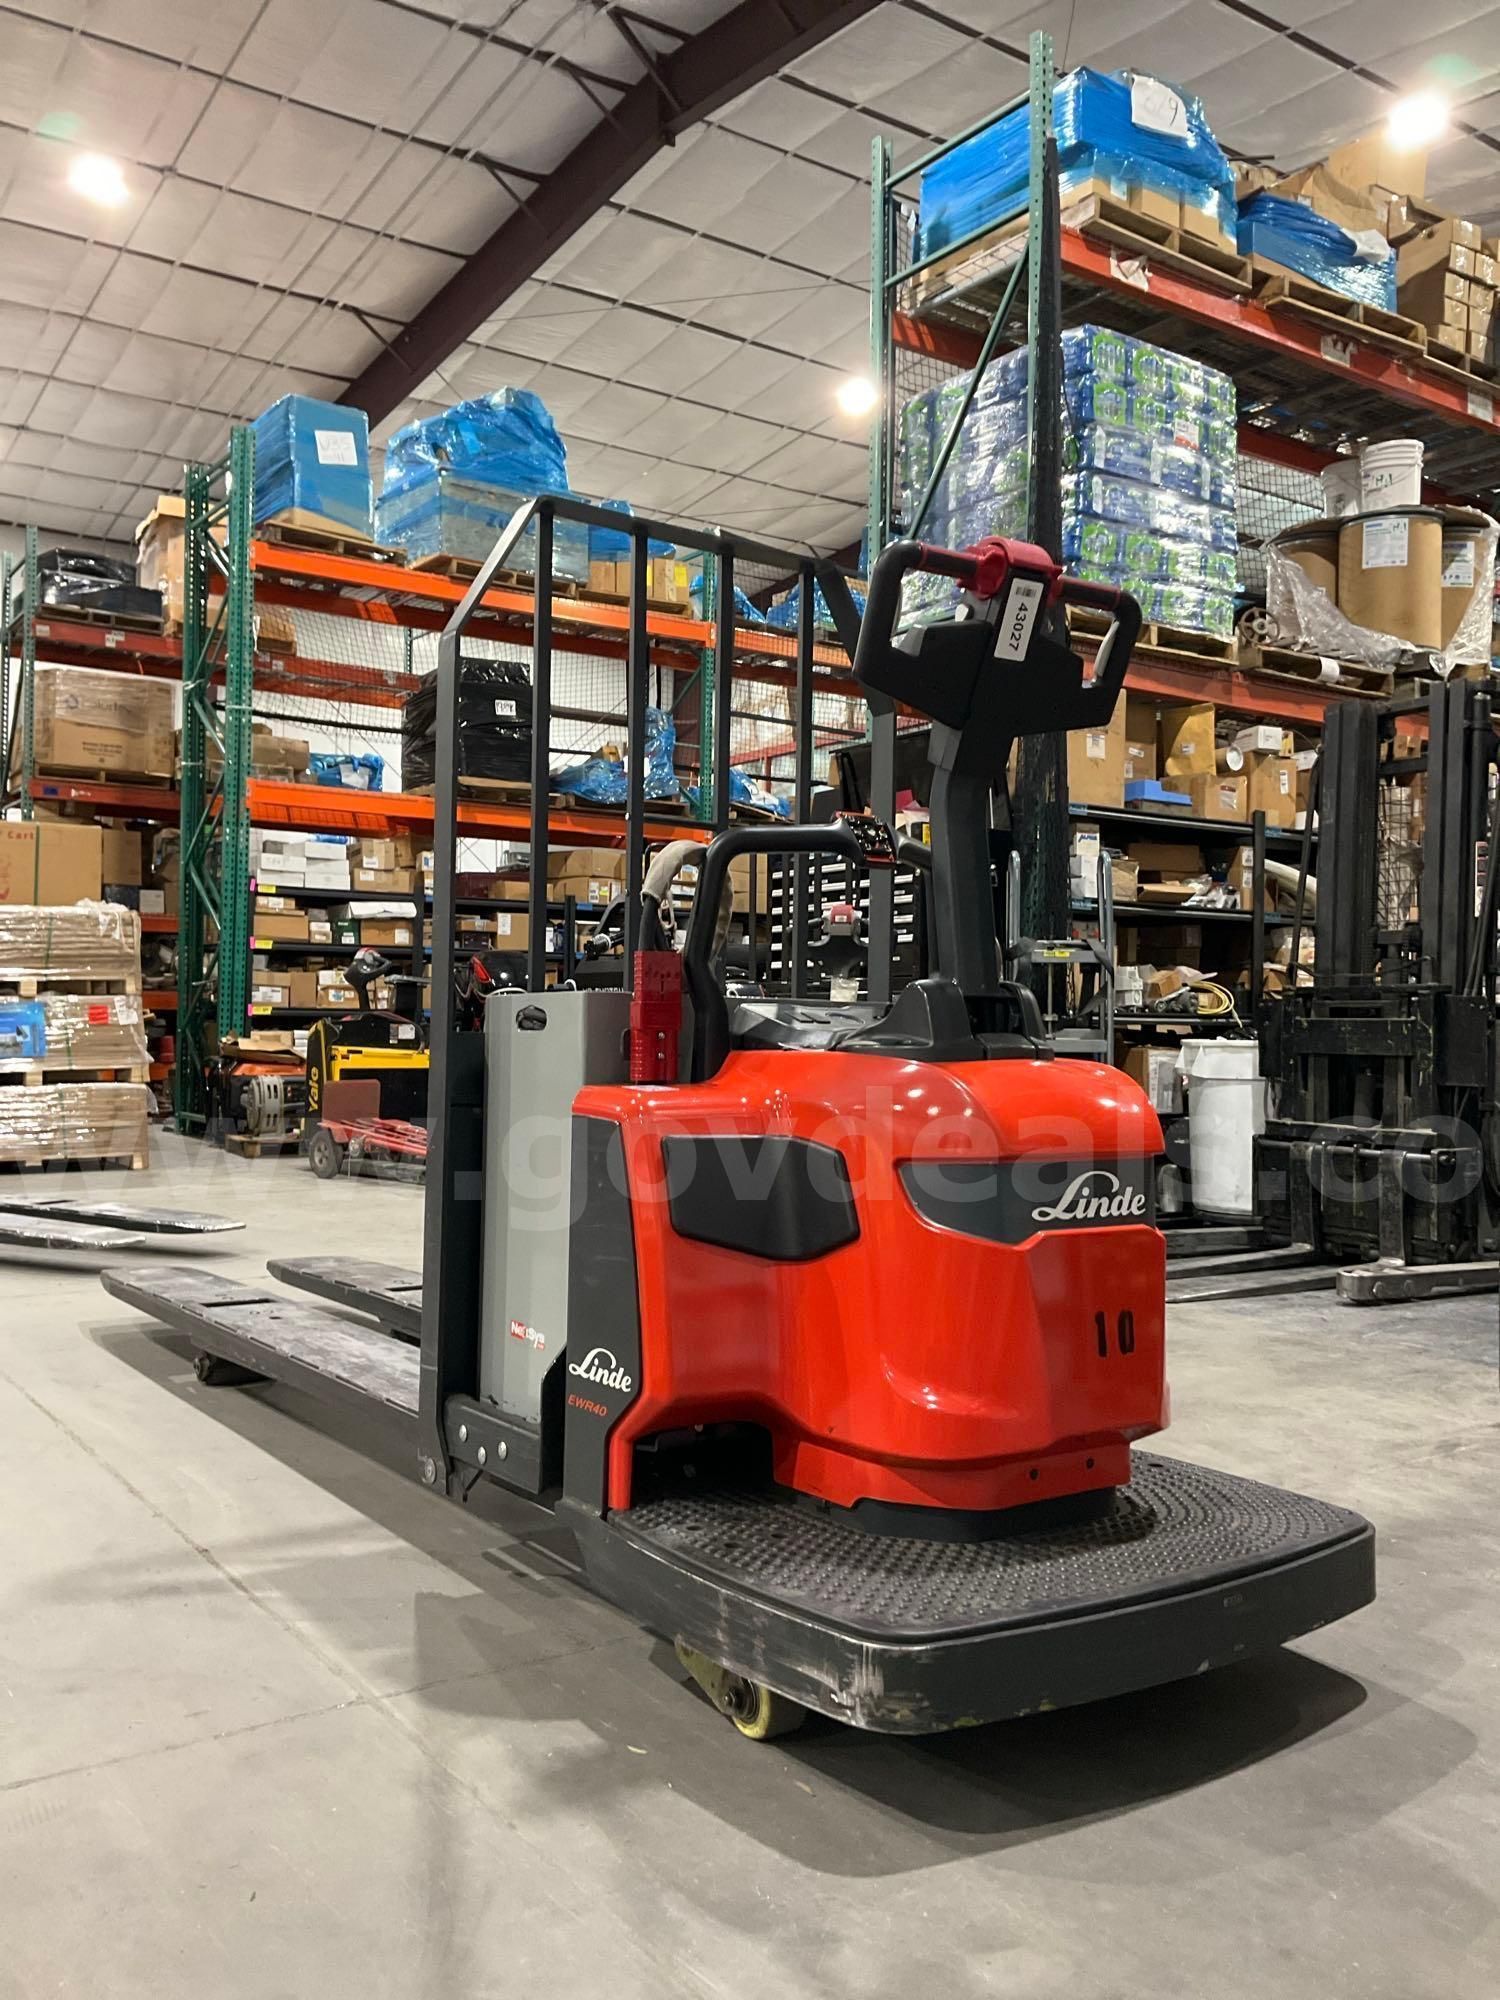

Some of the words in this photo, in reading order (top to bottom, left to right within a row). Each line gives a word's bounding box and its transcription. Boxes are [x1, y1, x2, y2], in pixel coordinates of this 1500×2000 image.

[1009, 602, 1029, 652] 43027
[308, 1066, 319, 1112] Yale
[1031, 1170, 1146, 1221] Linde
[1094, 1310, 1135, 1358] 10
[568, 1347, 632, 1393] Linde
[567, 1394, 608, 1417] EWR40
